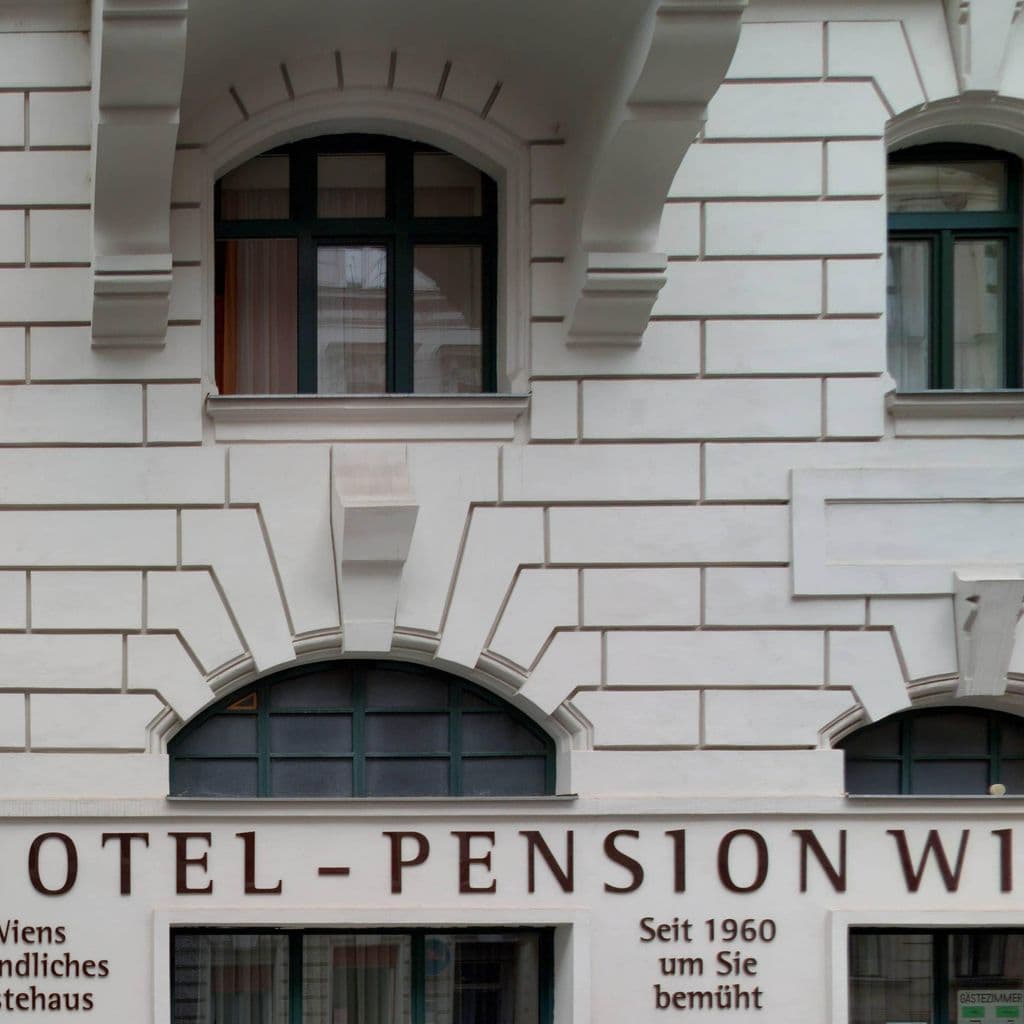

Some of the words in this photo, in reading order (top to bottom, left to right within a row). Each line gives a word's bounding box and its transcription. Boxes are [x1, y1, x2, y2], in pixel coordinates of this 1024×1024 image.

[381, 828, 847, 895] PENSION
[885, 828, 1013, 894] WI
[639, 916, 693, 943] Seit
[705, 917, 777, 943] 1960
[659, 957, 704, 977] um
[716, 950, 758, 977] Sie
[654, 983, 763, 1011] bemüht
